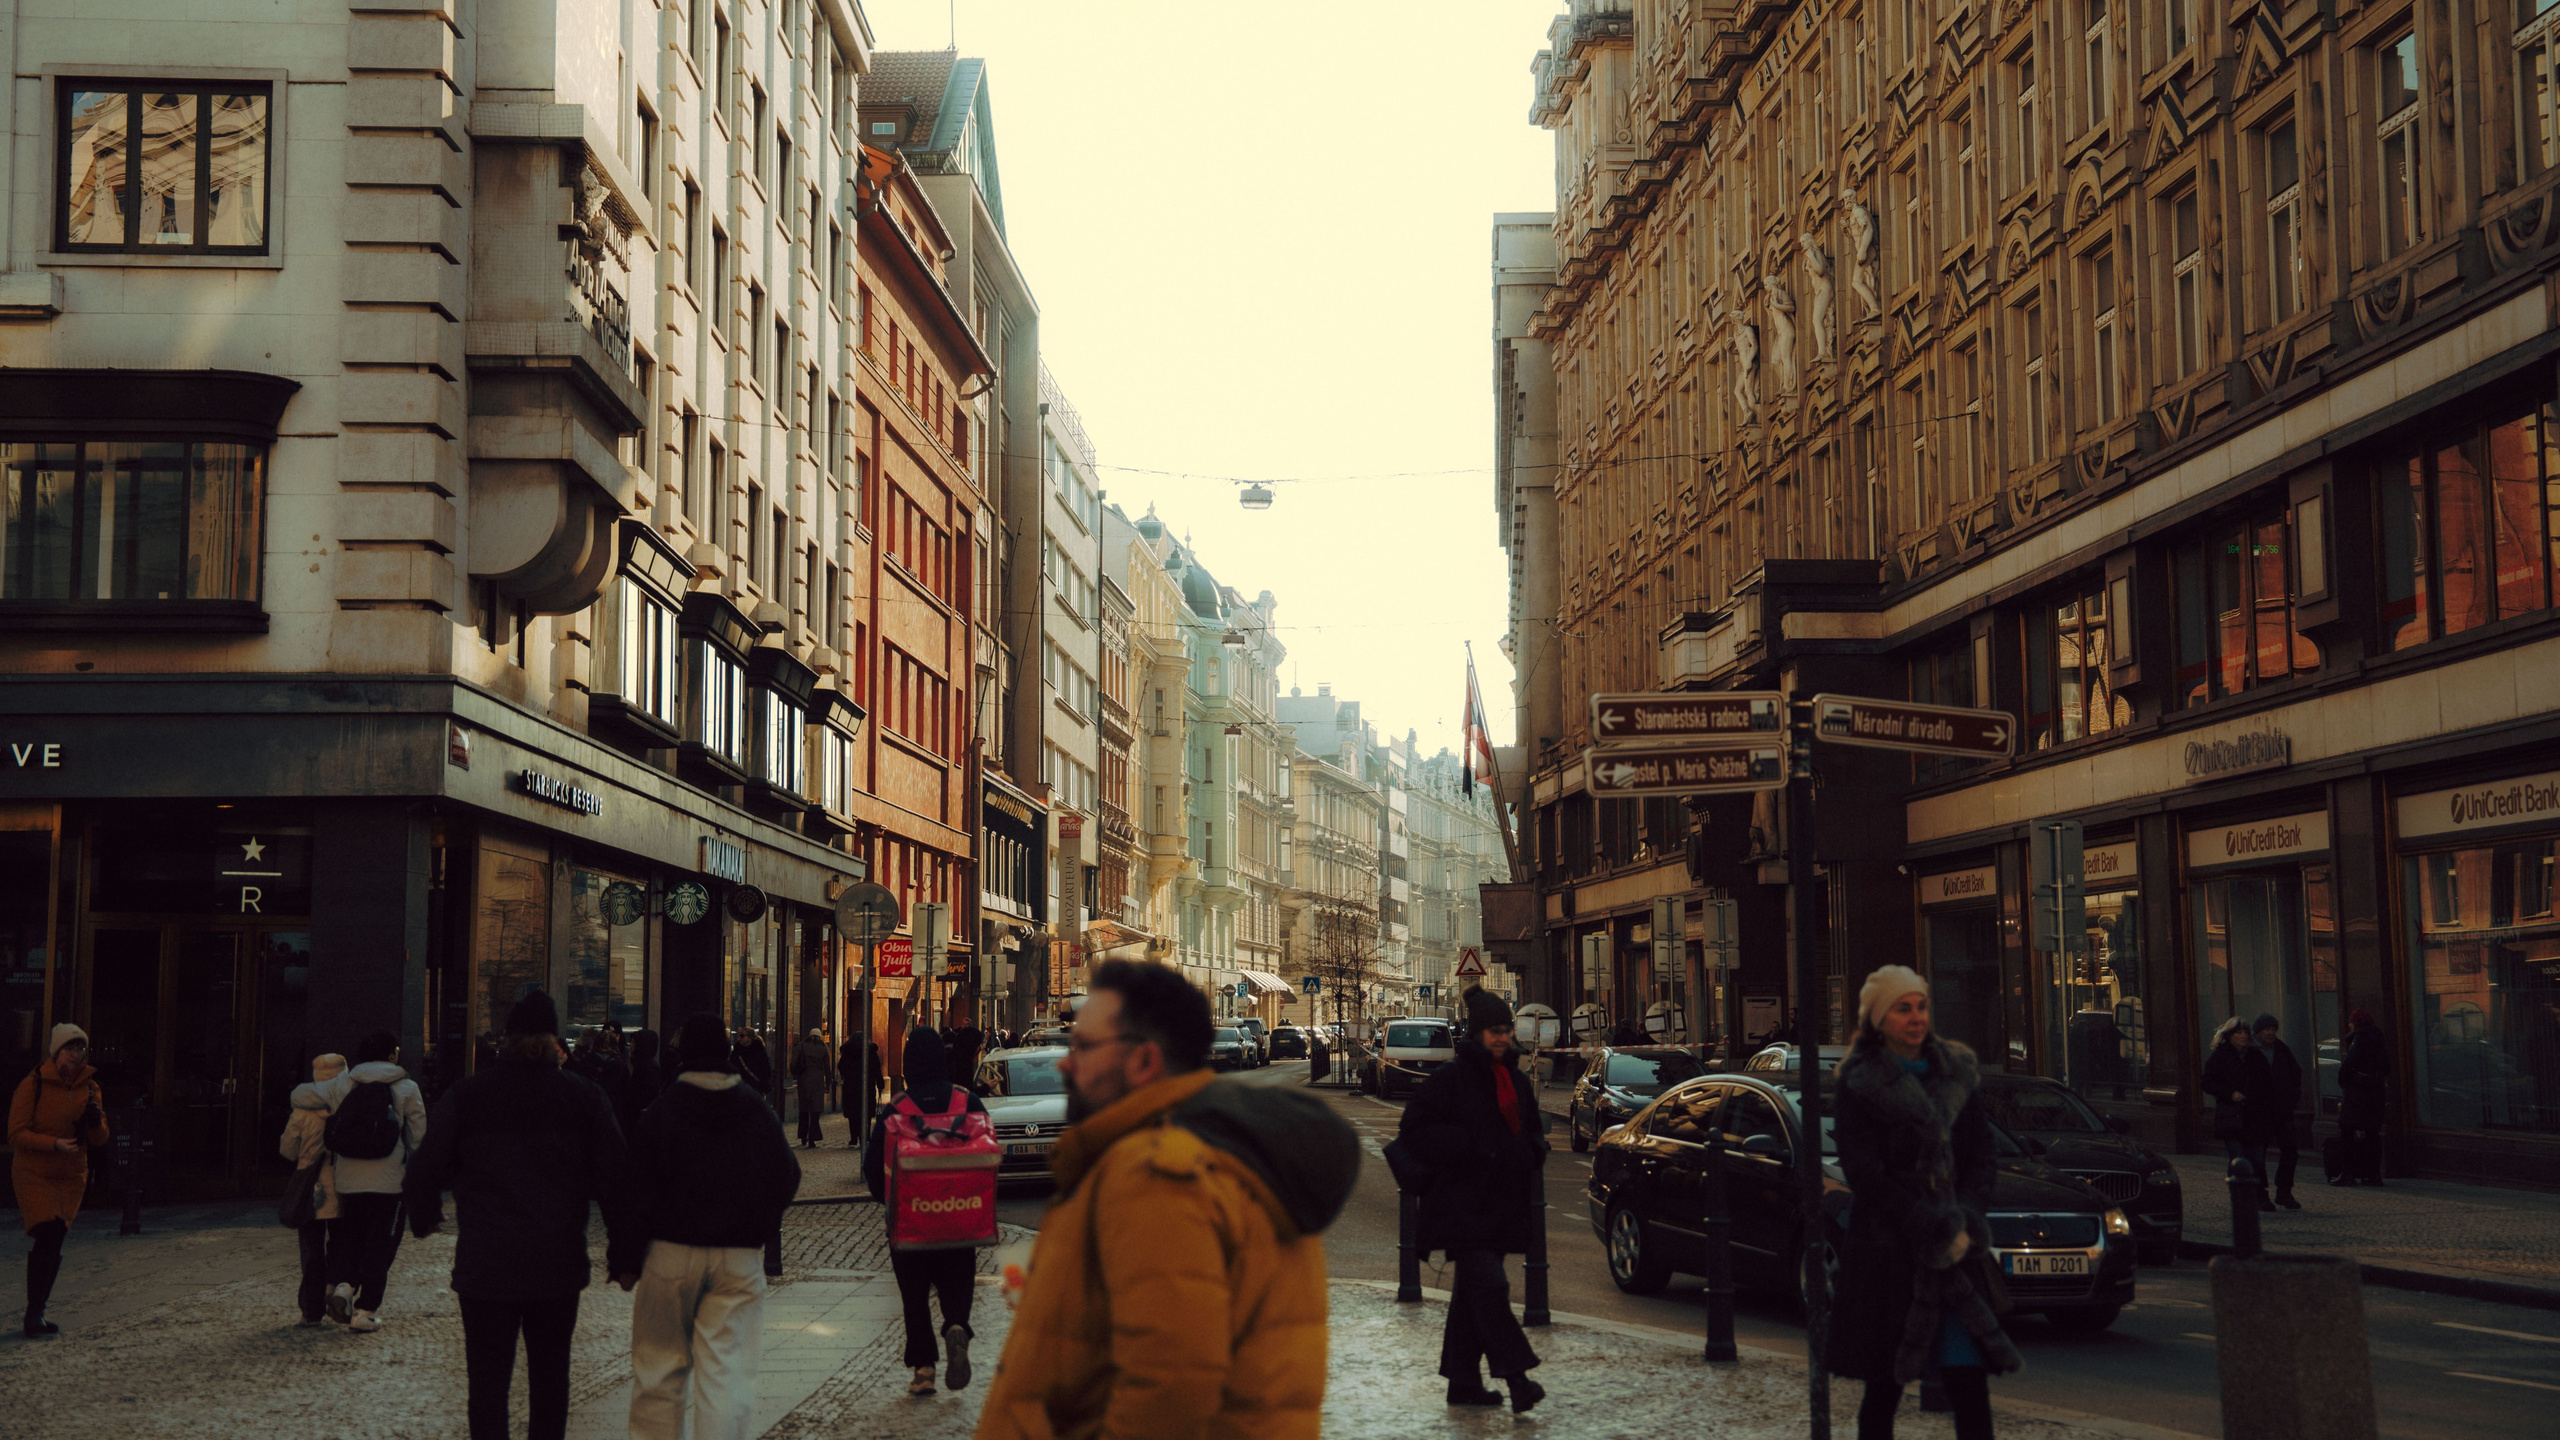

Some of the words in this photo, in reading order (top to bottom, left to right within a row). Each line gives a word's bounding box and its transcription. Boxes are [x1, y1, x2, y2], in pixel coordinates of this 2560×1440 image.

[1634, 705, 1708, 730] Staroměstská
[1710, 705, 1749, 728] radnice
[1854, 709, 1904, 736] Národní
[1908, 716, 1953, 741] divadlo
[0, 743, 61, 767] VE
[2251, 727, 2284, 762] Bank
[1675, 758, 1707, 780] Marie
[1709, 755, 1748, 779] Sněžné
[526, 769, 569, 805] STARBUCKS
[572, 786, 603, 817] RESERVE
[2466, 786, 2523, 821] UniCredit
[2525, 780, 2560, 813] Bank
[2236, 826, 2276, 854] UniCredit
[2277, 822, 2302, 849] Bank
[2101, 851, 2119, 873] Bank
[1065, 856, 1075, 928] MOZARTEUM
[1949, 875, 1971, 895] UniCredit
[1972, 873, 1986, 892] Bank
[241, 886, 262, 913] R
[911, 1195, 982, 1213] foodora
[2016, 1257, 2041, 1273] 1AM
[2050, 1257, 2083, 1273] D201
